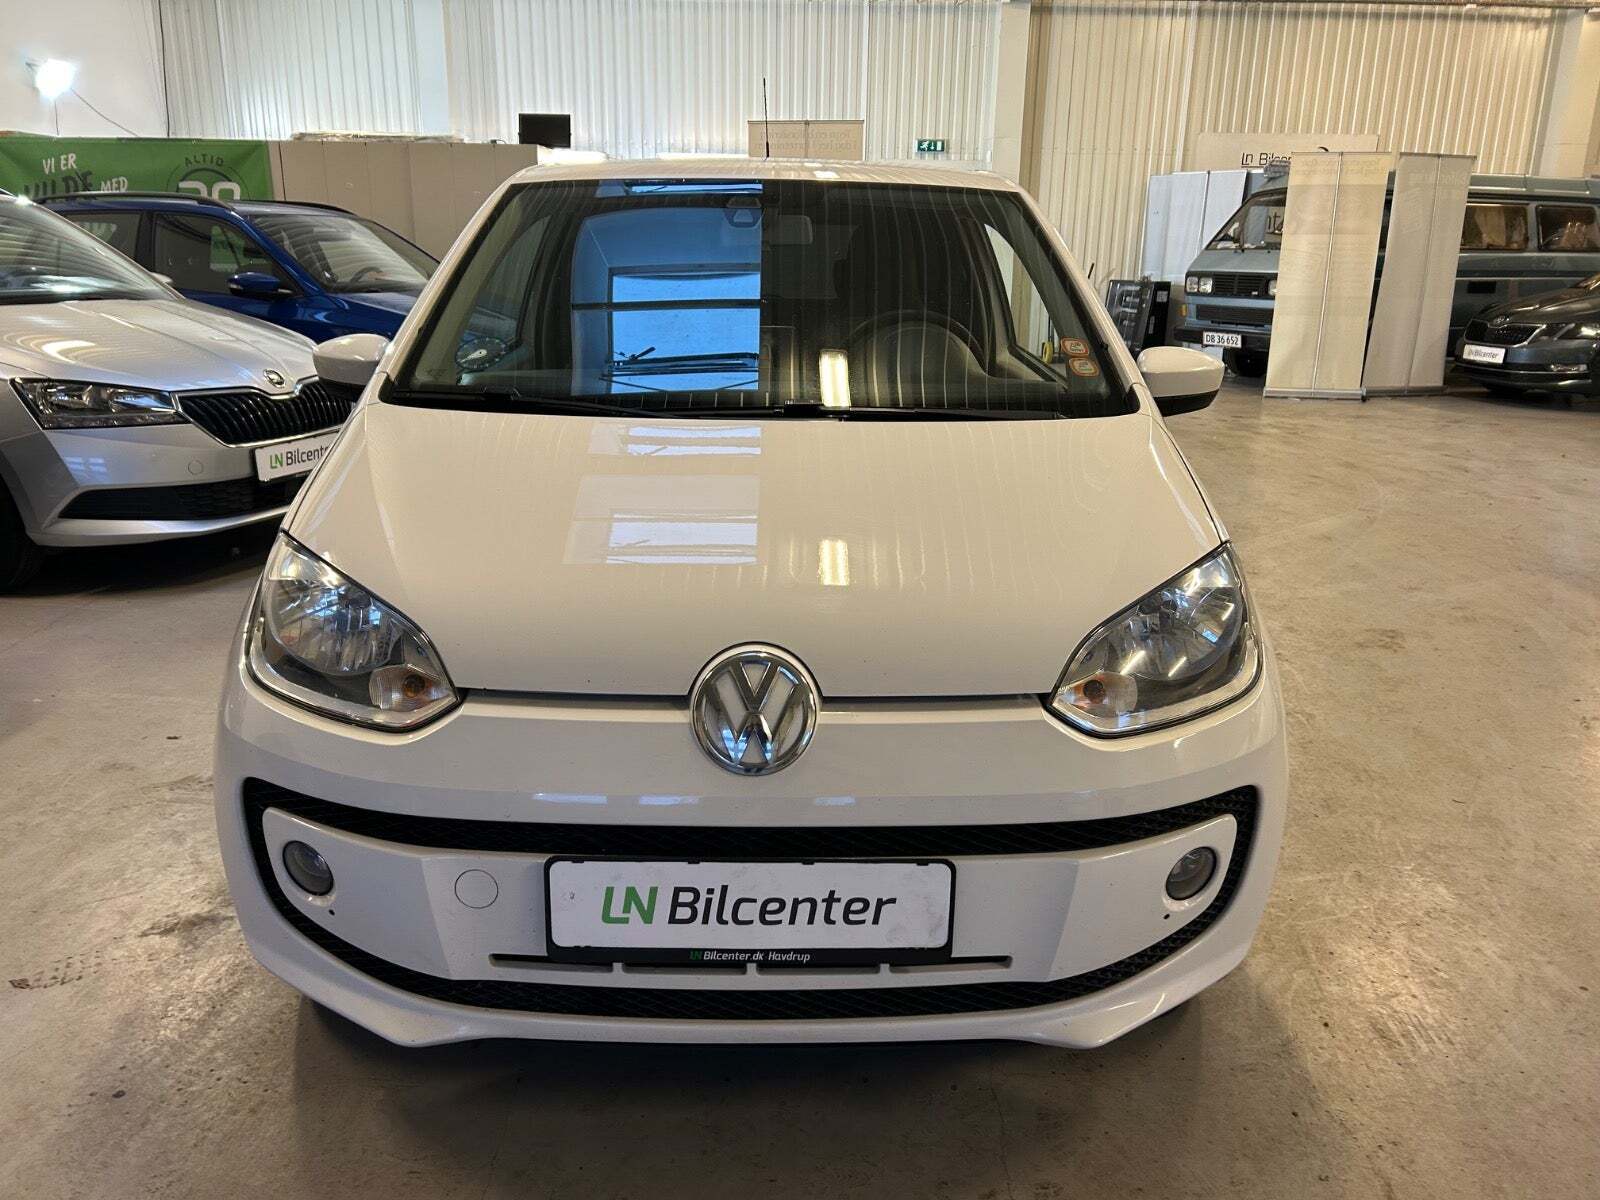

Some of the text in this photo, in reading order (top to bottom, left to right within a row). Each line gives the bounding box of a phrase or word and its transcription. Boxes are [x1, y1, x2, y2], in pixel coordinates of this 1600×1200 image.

[42, 153, 77, 175] VI ER
[184, 154, 224, 167] ALTID
[100, 176, 128, 193] MED
[1205, 334, 1216, 344] DB
[269, 452, 283, 469] LN
[600, 884, 897, 926] LN Bilcenter
[703, 951, 765, 961] Bilcenter.dk
[768, 951, 811, 964] Havdrup
